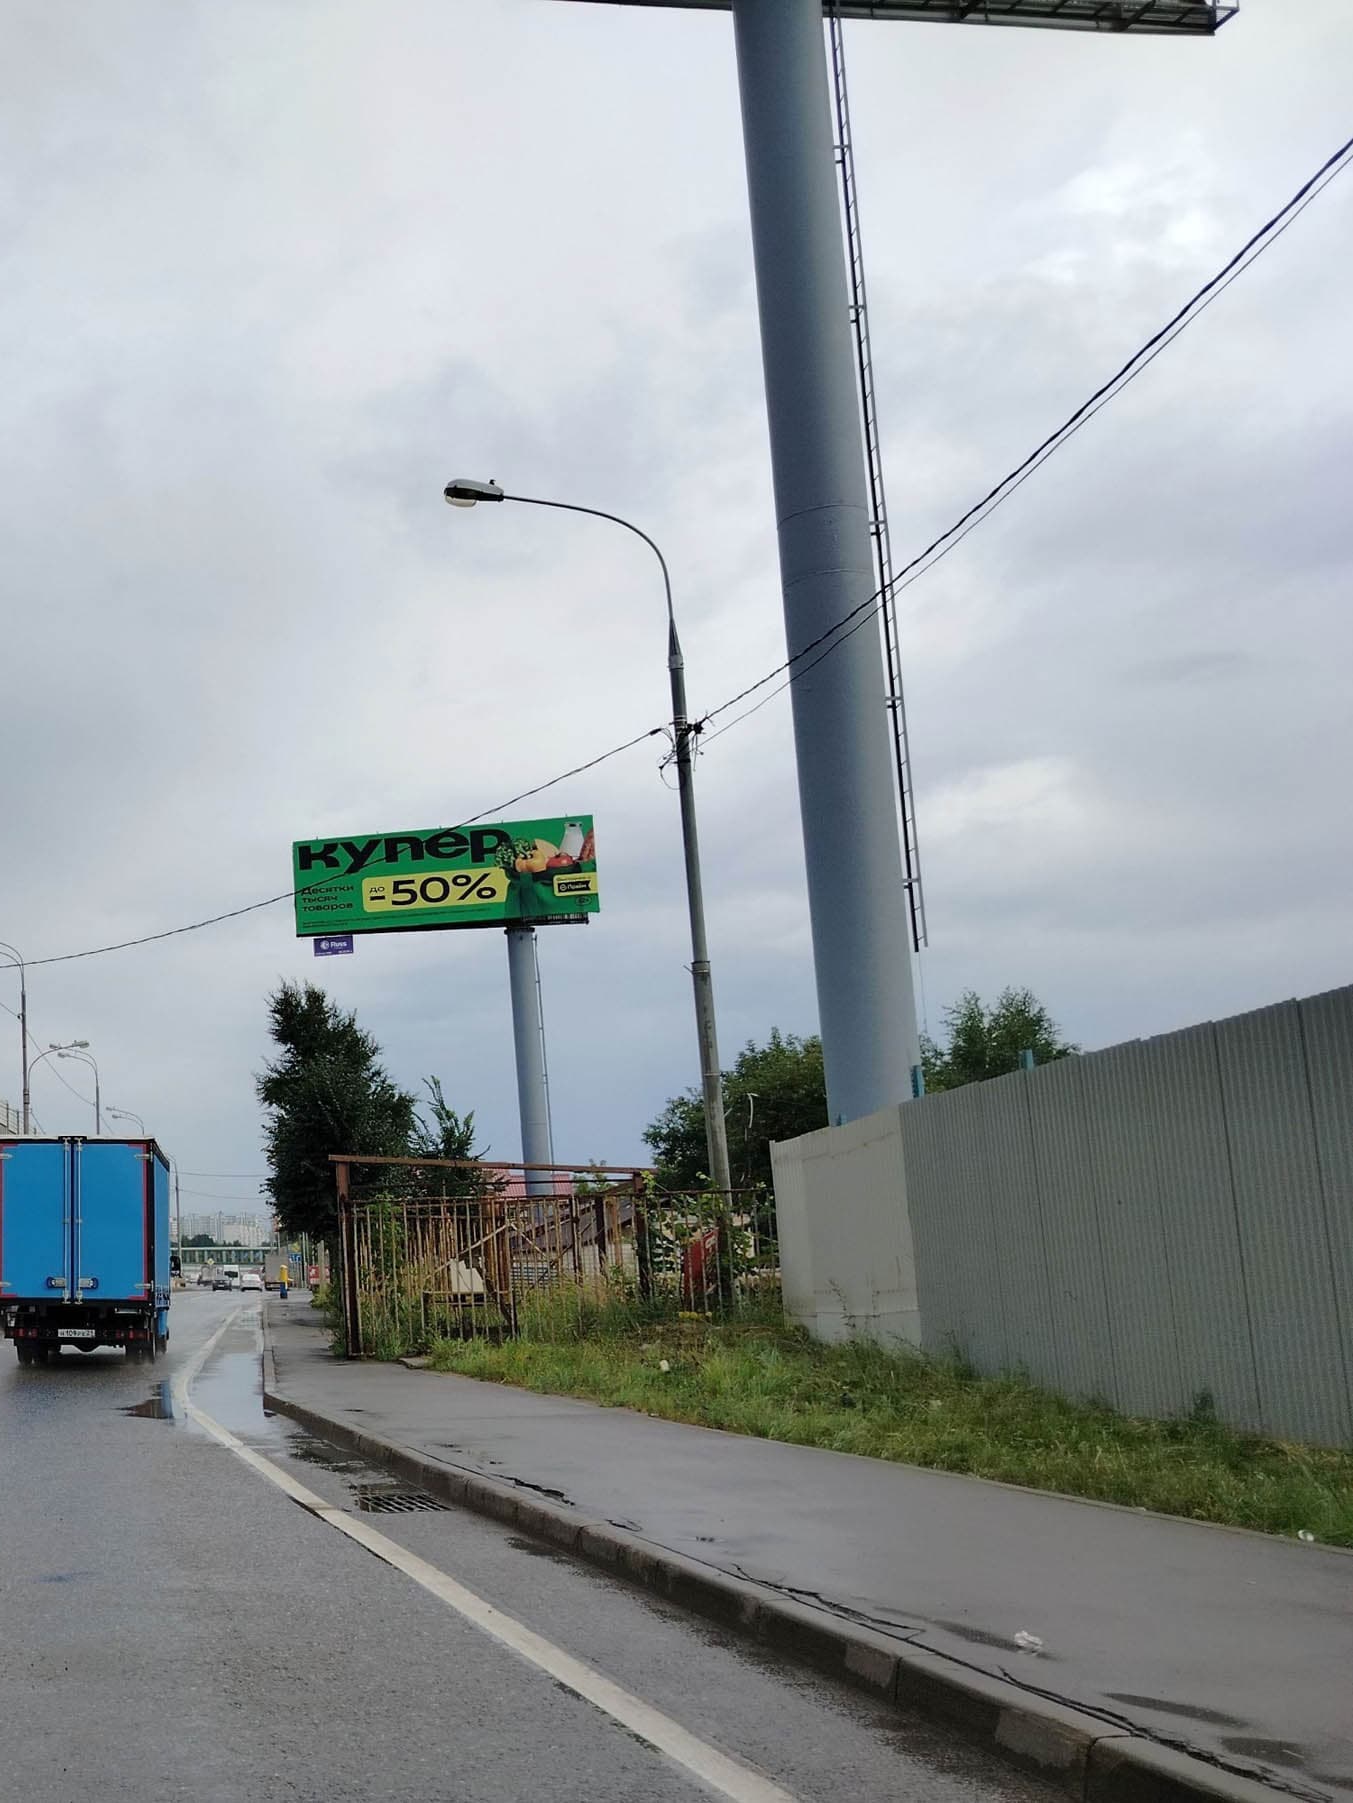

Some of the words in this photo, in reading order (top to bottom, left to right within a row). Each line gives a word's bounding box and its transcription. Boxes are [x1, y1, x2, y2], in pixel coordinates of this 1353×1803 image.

[301, 885, 354, 896] Десятки
[302, 895, 338, 904] тысяч
[302, 903, 354, 913] товаров
